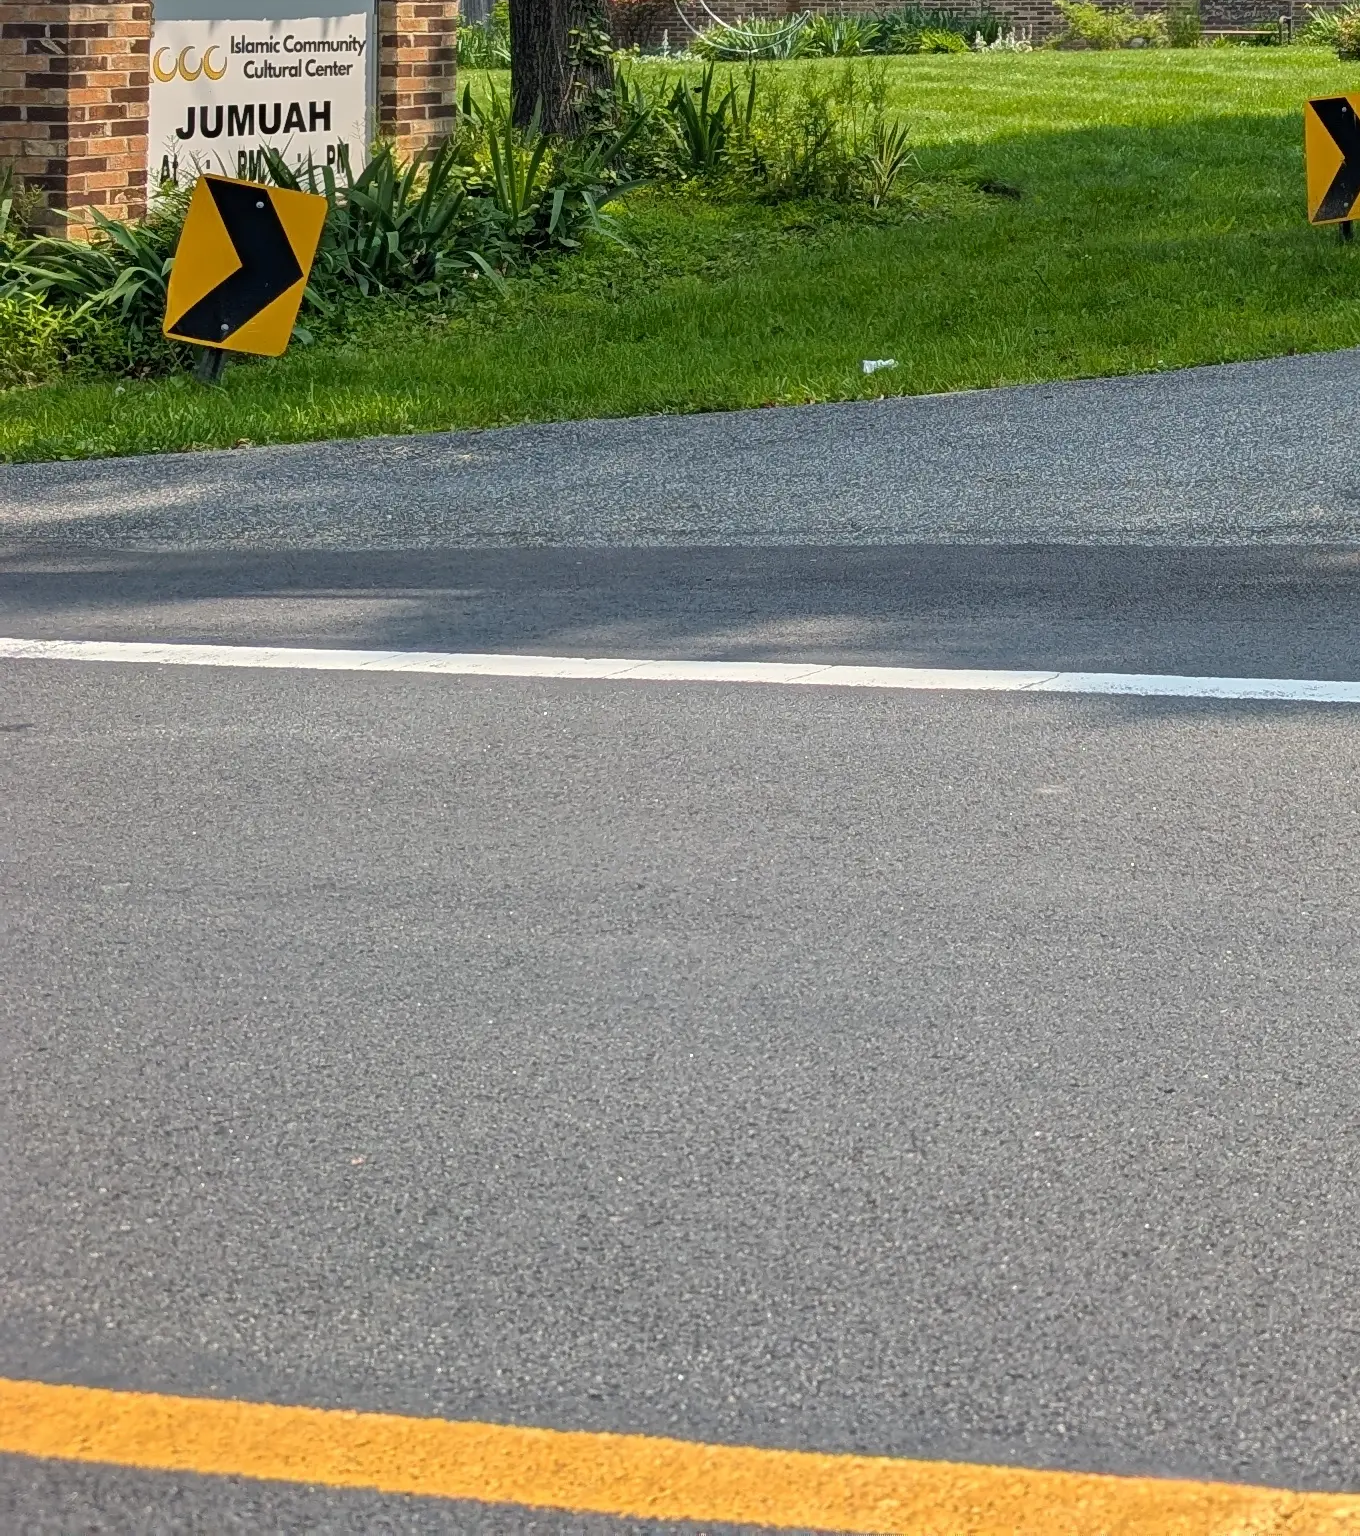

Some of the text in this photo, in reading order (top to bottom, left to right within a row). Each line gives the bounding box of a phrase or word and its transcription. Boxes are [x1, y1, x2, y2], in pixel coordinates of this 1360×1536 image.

[230, 35, 366, 56] Islamic Community
[243, 59, 353, 78] Cultural Center
[176, 100, 331, 140] JUMUAH
